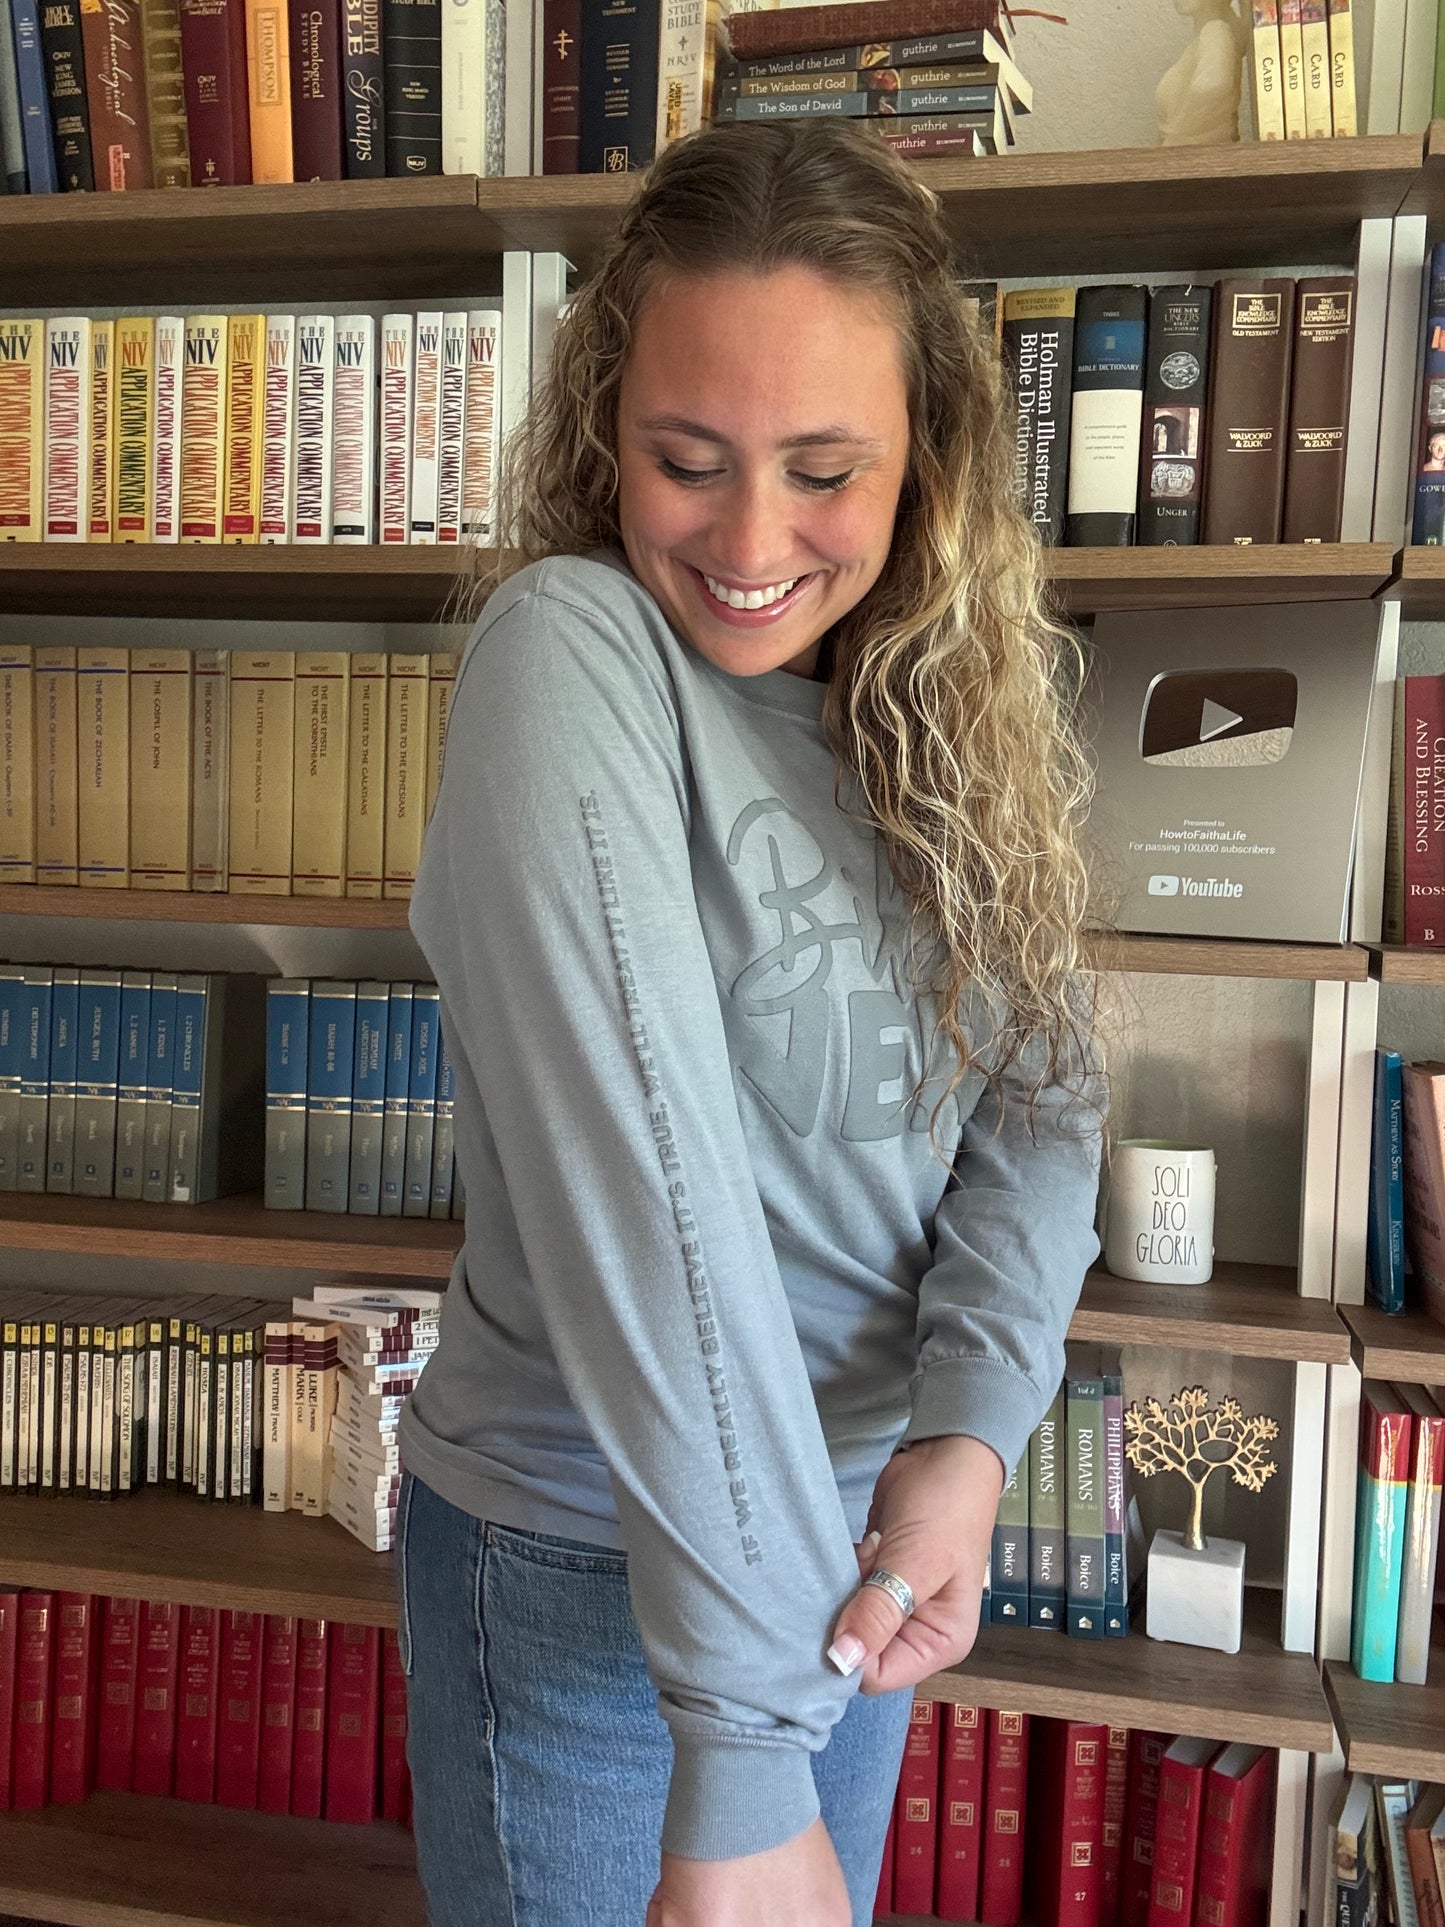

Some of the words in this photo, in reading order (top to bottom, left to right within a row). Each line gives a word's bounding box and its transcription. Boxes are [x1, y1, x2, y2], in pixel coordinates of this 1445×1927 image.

[45, 15, 74, 28] BIBLE
[46, 5, 70, 18] HOLY
[666, 13, 701, 30] BIBLE
[668, 4, 701, 17] STUDY
[301, 13, 309, 54] STUDY
[902, 41, 938, 58] guthrie
[262, 13, 277, 99] THOMPSON
[310, 11, 324, 98] Chronological
[749, 65, 766, 77] The
[768, 61, 794, 74] Word
[795, 60, 806, 71] of
[806, 58, 823, 70] the
[824, 54, 846, 67] Lord
[1334, 51, 1346, 88] CARD
[302, 61, 311, 99] BIBLE
[748, 83, 765, 95] The
[767, 80, 810, 94] Wisdom
[812, 78, 823, 91] of
[823, 77, 846, 90] God
[911, 69, 951, 87] guthrie
[1262, 56, 1274, 93] CARD
[1287, 54, 1299, 90] CARD
[1310, 53, 1322, 89] CARD
[346, 69, 383, 161] Groups
[758, 101, 776, 114] The
[778, 101, 798, 113] Son
[800, 100, 811, 112] of
[812, 98, 842, 111] David
[911, 93, 949, 108] guthrie
[911, 119, 949, 136] guthrie
[1016, 297, 1047, 306] REVISED
[1049, 296, 1065, 304] AND
[1020, 303, 1060, 312] EXPANDED
[51, 342, 79, 367] NIV
[122, 342, 148, 366] NIV
[186, 339, 219, 364] NIV
[300, 338, 324, 363] NIV
[337, 342, 364, 366] NIV
[386, 341, 406, 366] NIV
[420, 334, 438, 352] NIV
[470, 338, 496, 362] NIV
[1018, 333, 1038, 387] Bible
[1038, 331, 1059, 416] Holman
[1078, 363, 1097, 373] BIBLE
[1099, 363, 1140, 372] DICTIONARY
[416, 352, 438, 403] APPLICATION
[50, 367, 79, 440] APPLICATION
[120, 367, 147, 437] APPLICATION
[184, 366, 219, 440] APPLICATION
[298, 365, 324, 438] APPLICATION
[335, 368, 364, 436] APPLICATION
[385, 367, 407, 442] APPLICATION
[466, 363, 494, 433] APPLICATION
[415, 405, 436, 461] COMMENTARY
[1229, 432, 1272, 440] WALVOORD
[1242, 439, 1263, 447] ZUCK
[1298, 431, 1343, 440] WALVOORD
[1311, 439, 1333, 447] ZUCK
[49, 442, 78, 519] COMMENTARY
[119, 440, 146, 516] COMMENTARY
[182, 442, 217, 522] COMMENTARY
[297, 441, 323, 521] COMMENTARY
[334, 438, 363, 513] COMMENTARY
[384, 446, 405, 526] COMMENTARY
[463, 436, 492, 509] COMMENTARY
[1033, 420, 1056, 523] Illustrated
[1157, 507, 1188, 517] UNGER
[311, 685, 318, 697] TO
[256, 706, 264, 736] LETTER
[400, 702, 408, 733] LETTER
[256, 738, 263, 749] TO
[310, 718, 318, 777] CORINTHIANS
[320, 728, 328, 758] EPISTLE
[400, 736, 407, 748] TO
[1416, 718, 1429, 759] AND
[399, 750, 407, 766] THE
[255, 765, 263, 804] ROMANS
[398, 769, 406, 819] EPHESIANS
[580, 789, 602, 821] IS.
[1415, 766, 1431, 853] BLESSING
[586, 825, 609, 850] IT
[1160, 829, 1247, 841] HowtoFaithaLife
[1183, 819, 1216, 827] Presented
[1129, 841, 1144, 851] For
[1145, 843, 1180, 854] passing
[1183, 843, 1219, 853] 100,000
[1221, 844, 1276, 855] subscribers
[593, 855, 620, 909] LIKE
[1181, 877, 1244, 898] YouTube
[605, 914, 626, 940] IT
[611, 947, 642, 1020] TREAT
[420, 1022, 429, 1049] HOSEA
[630, 1024, 662, 1099] WE'LL
[1390, 1099, 1401, 1143] MATTHEW
[1392, 1144, 1399, 1156] AS
[1152, 1165, 1190, 1198] SOLI
[1391, 1156, 1402, 1182] STORY
[668, 1181, 697, 1234] IT'S
[1152, 1200, 1186, 1231] DEO
[1136, 1232, 1198, 1266] GLORIA
[681, 1240, 721, 1356] BELIEVE
[123, 1373, 131, 1395] SONG
[123, 1395, 131, 1405] OF
[272, 1368, 280, 1413] MATTHEW
[295, 1368, 304, 1400] MARK
[308, 1374, 317, 1403] LUKE
[122, 1406, 131, 1441] SOLOMON
[706, 1364, 741, 1471] REALLY
[1040, 1421, 1055, 1494] ROMANS
[1078, 1429, 1093, 1501] ROMANS
[1108, 1417, 1121, 1510] PHILIPPIANS
[730, 1478, 752, 1529] WE
[742, 1535, 763, 1566] IF
[1004, 1542, 1016, 1577] Boice
[1041, 1546, 1053, 1581] Boice
[1079, 1554, 1092, 1590] Boice
[1110, 1552, 1121, 1585] Boice
[911, 1847, 922, 1856] 24
[955, 1851, 966, 1859] 25
[1075, 1892, 1087, 1901] 27
